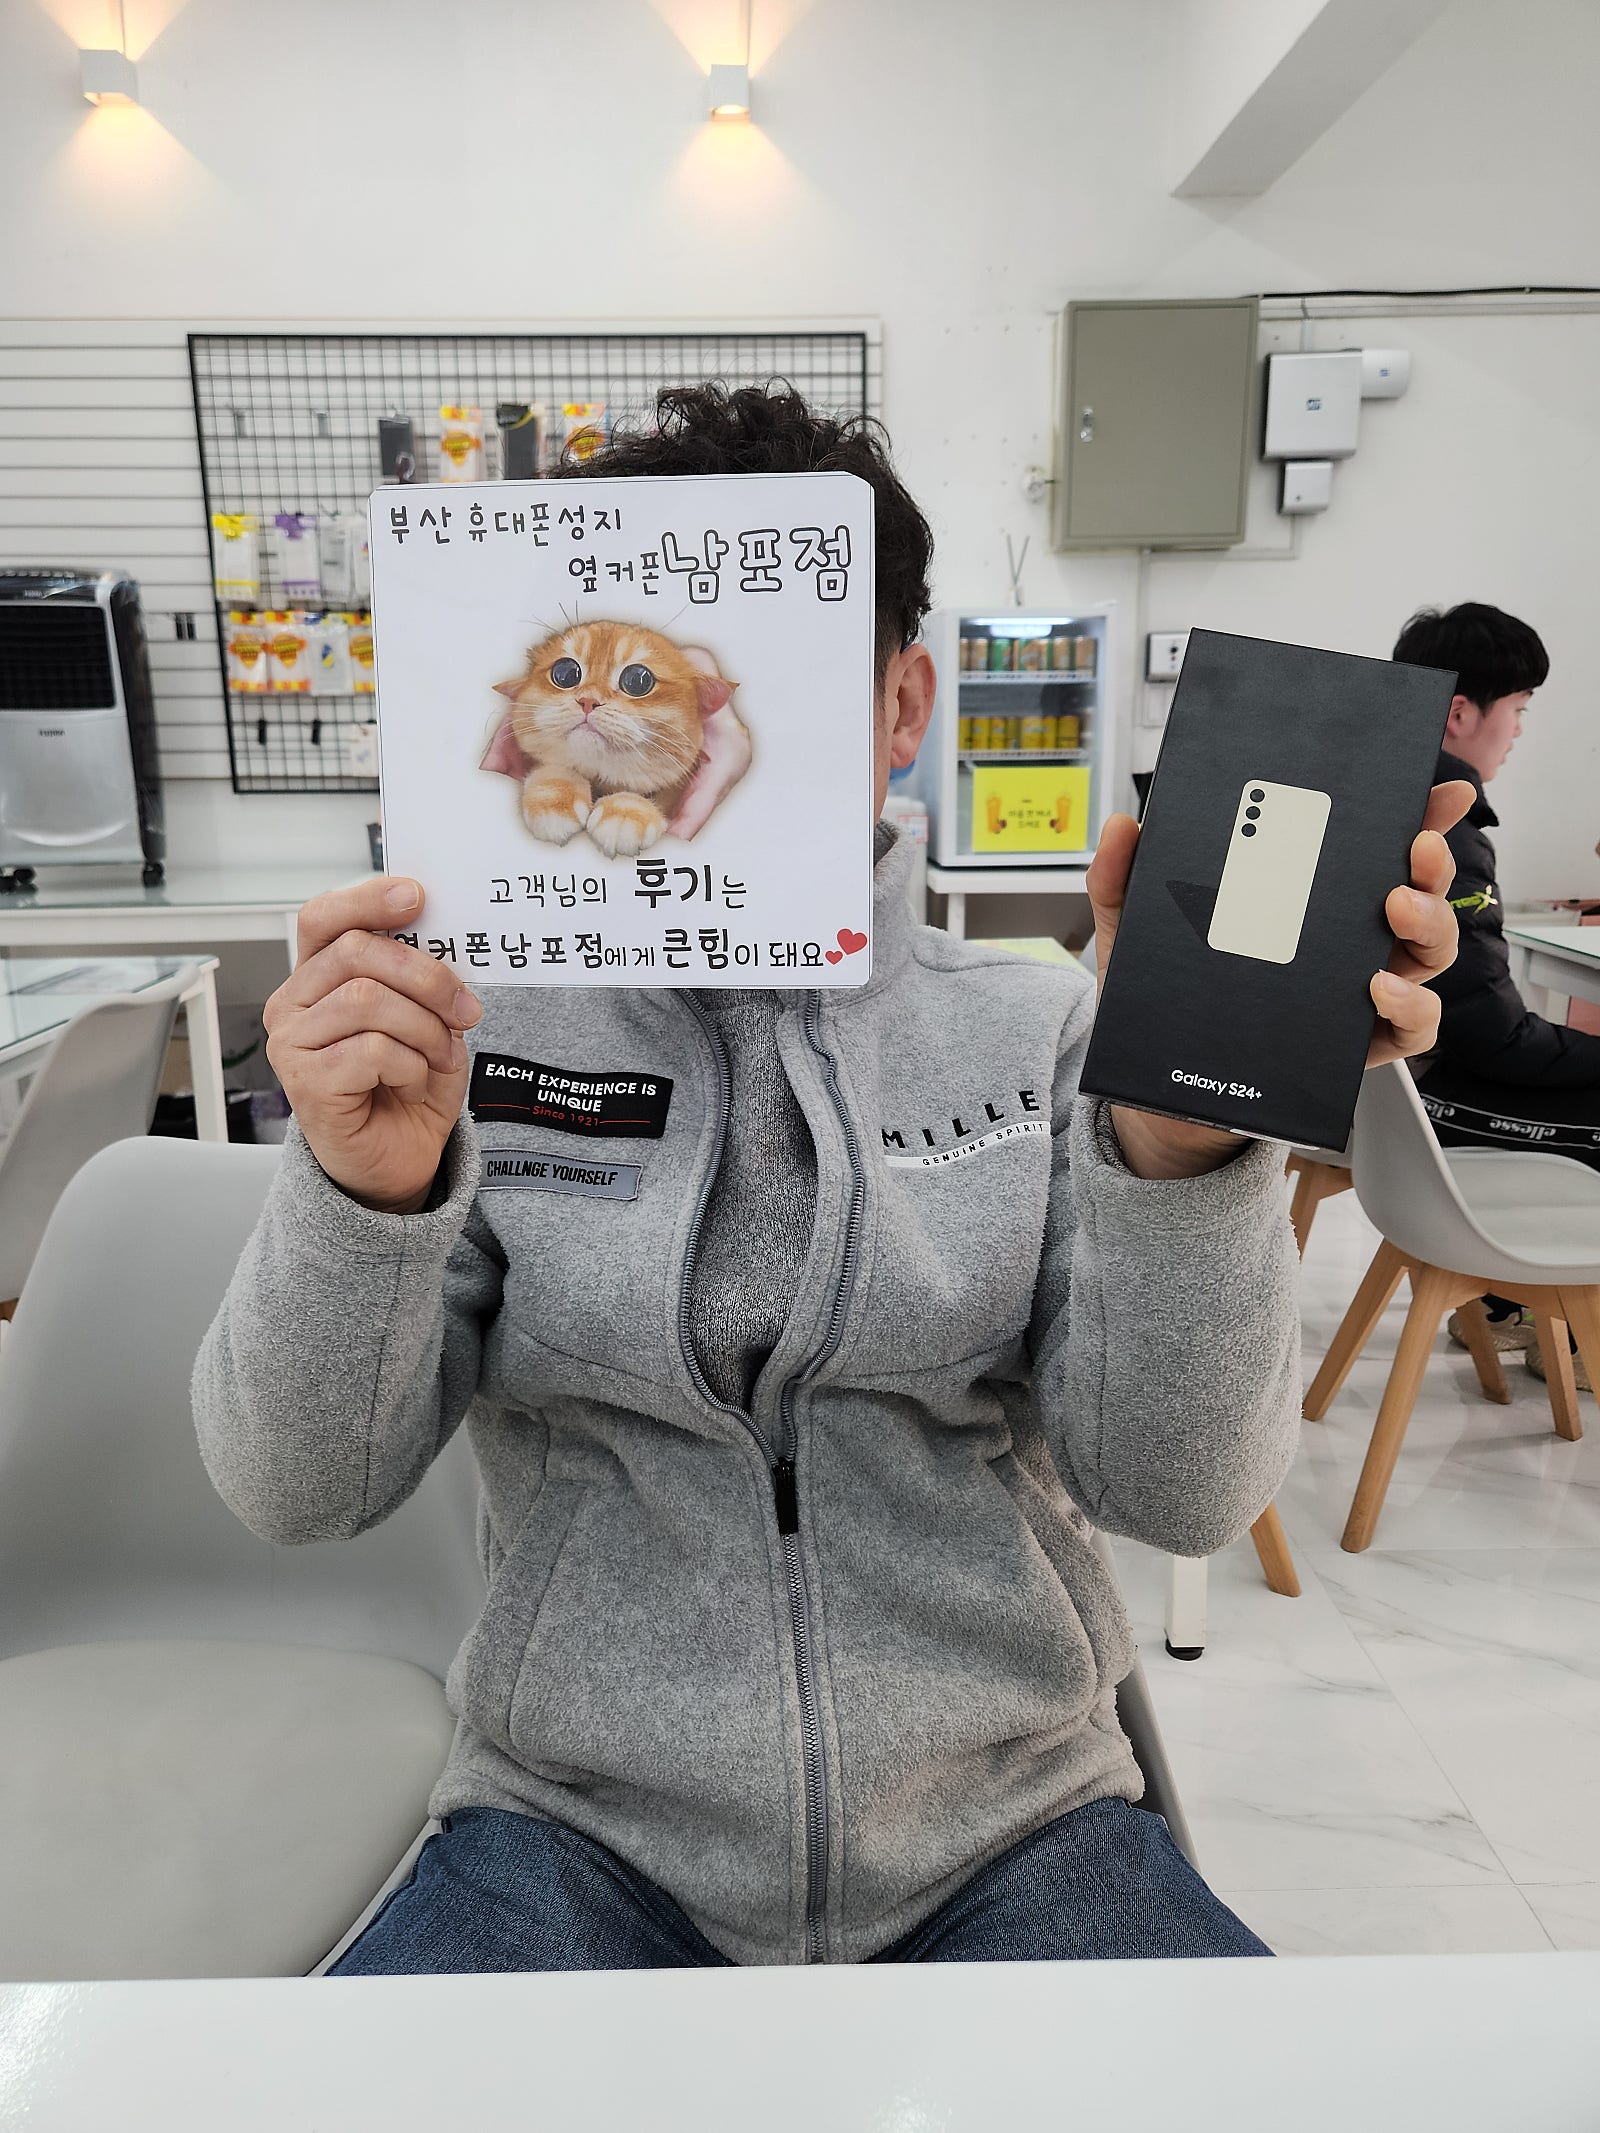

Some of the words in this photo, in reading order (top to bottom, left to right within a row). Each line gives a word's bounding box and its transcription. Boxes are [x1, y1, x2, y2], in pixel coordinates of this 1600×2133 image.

[390, 505, 452, 544] 부산
[489, 874, 607, 908] 고객님의
[634, 858, 747, 909] 후기는
[768, 941, 824, 967] 돼요
[485, 1063, 534, 1082] EACH
[537, 1073, 637, 1096] EXPERIENCE
[641, 1082, 657, 1096] IS
[1170, 1069, 1228, 1096] Galaxy
[1228, 1082, 1263, 1100] S24+
[531, 1105, 566, 1120] Since
[569, 1113, 600, 1127] 1921
[537, 1089, 602, 1113] UNIQUE
[881, 1089, 1041, 1149] MILLE
[1488, 1117, 1557, 1141] ellesse
[922, 1139, 986, 1166] GENUINE
[995, 1122, 1045, 1141] SPIRIT
[486, 1159, 550, 1178] CHALLNGE
[552, 1163, 619, 1186] YOURSELF
